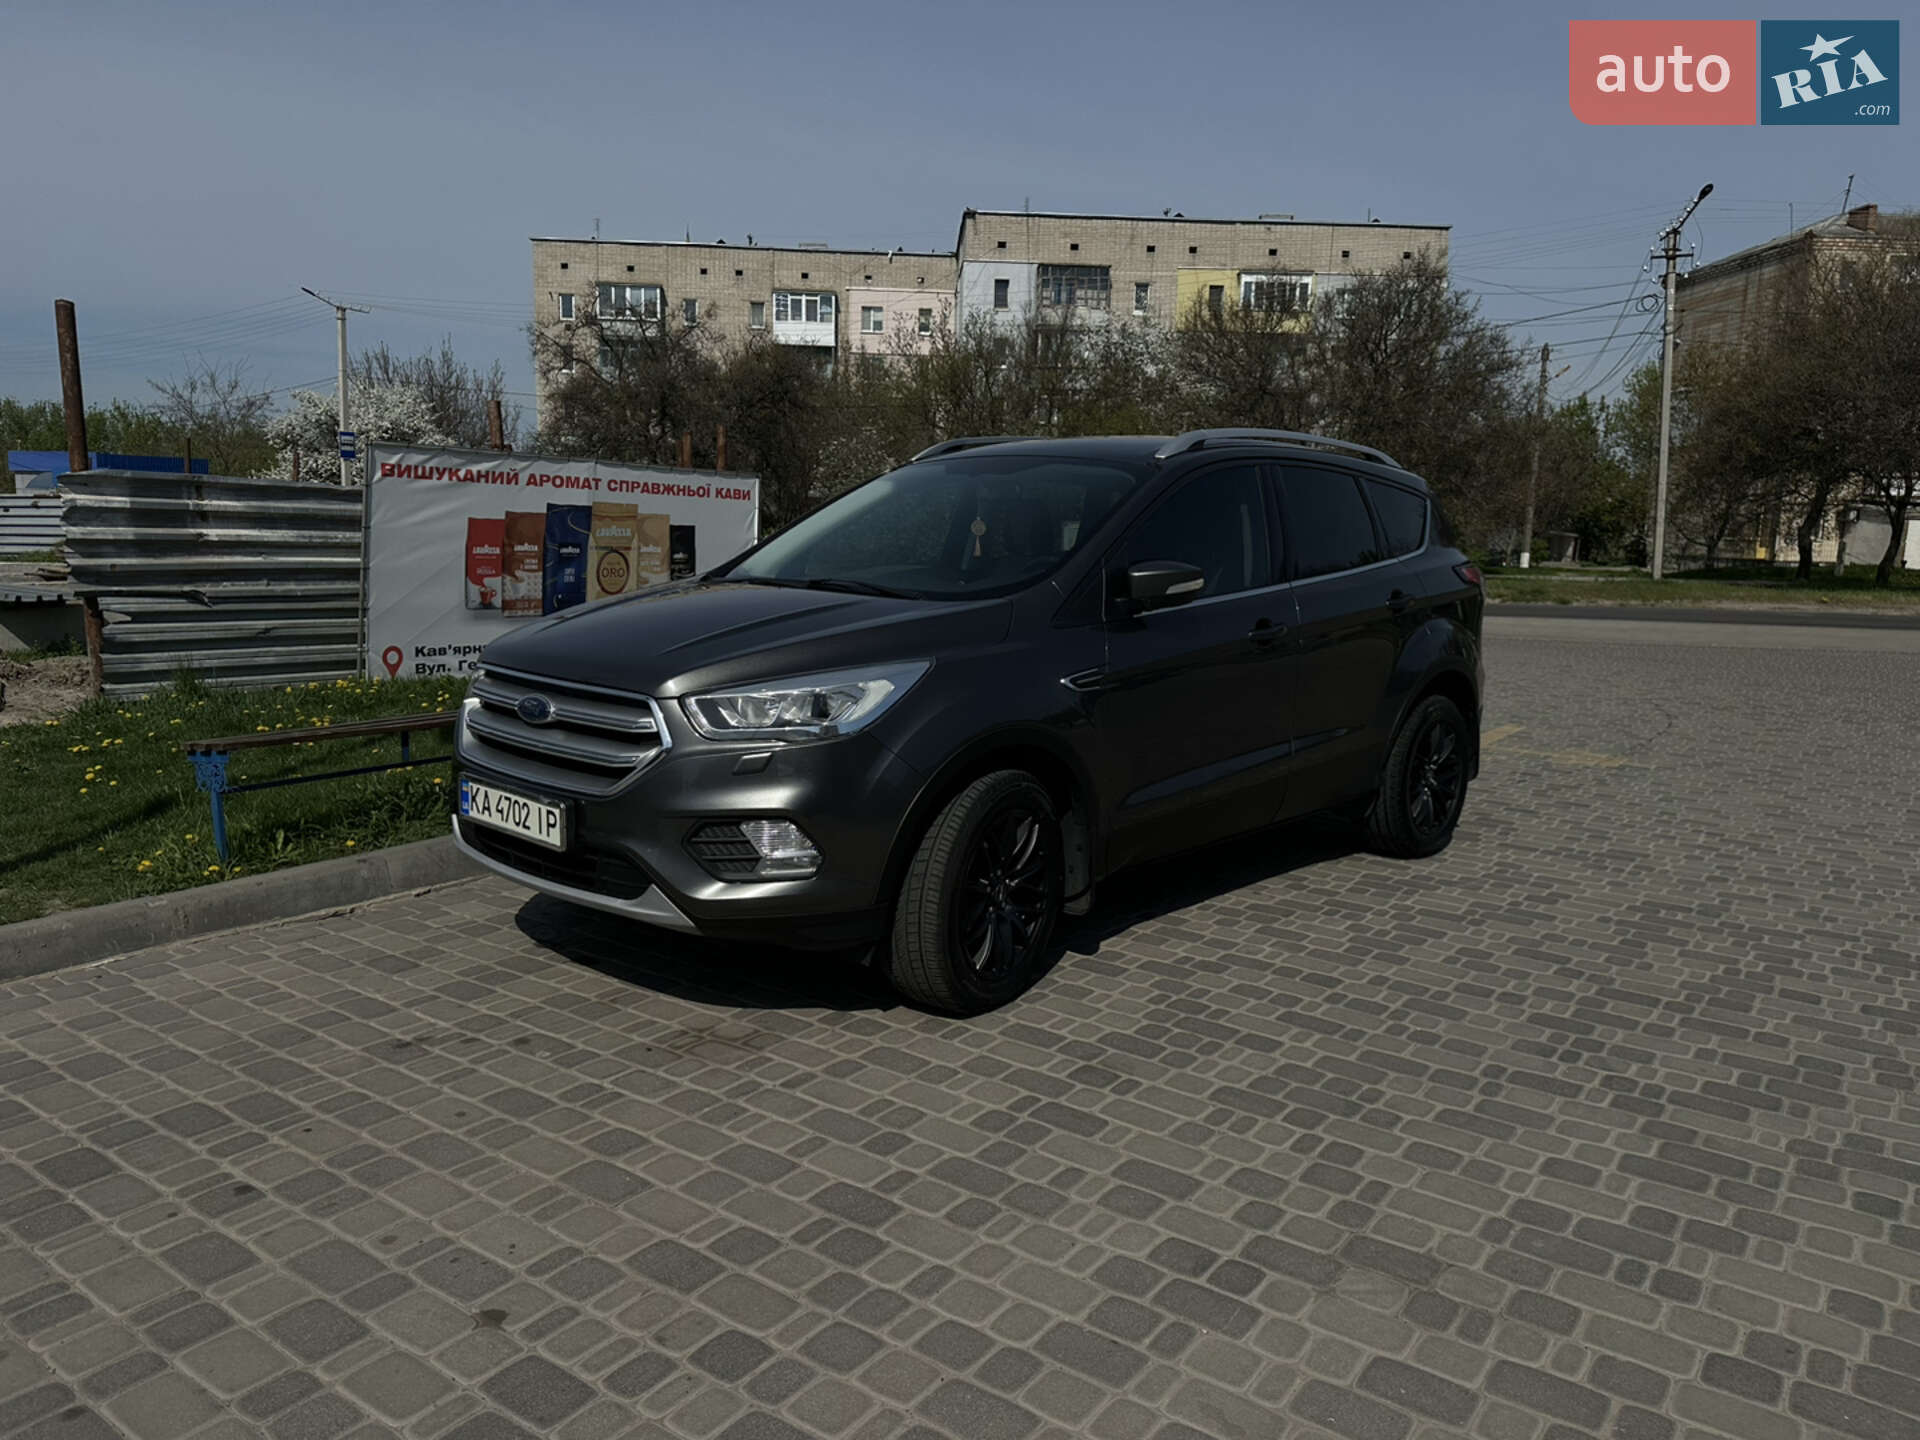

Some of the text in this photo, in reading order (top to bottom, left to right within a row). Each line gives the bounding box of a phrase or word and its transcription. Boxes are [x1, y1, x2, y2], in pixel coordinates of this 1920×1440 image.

[380, 462, 751, 501] ВИШУКАНИЙ АРОМАТ СПРАВЖНЬОЇ КАВИ
[601, 567, 626, 578] ORO
[415, 644, 487, 658] Кав'ярн
[415, 659, 478, 676] Вул. Ге
[470, 784, 558, 838] KA 4702 IP
